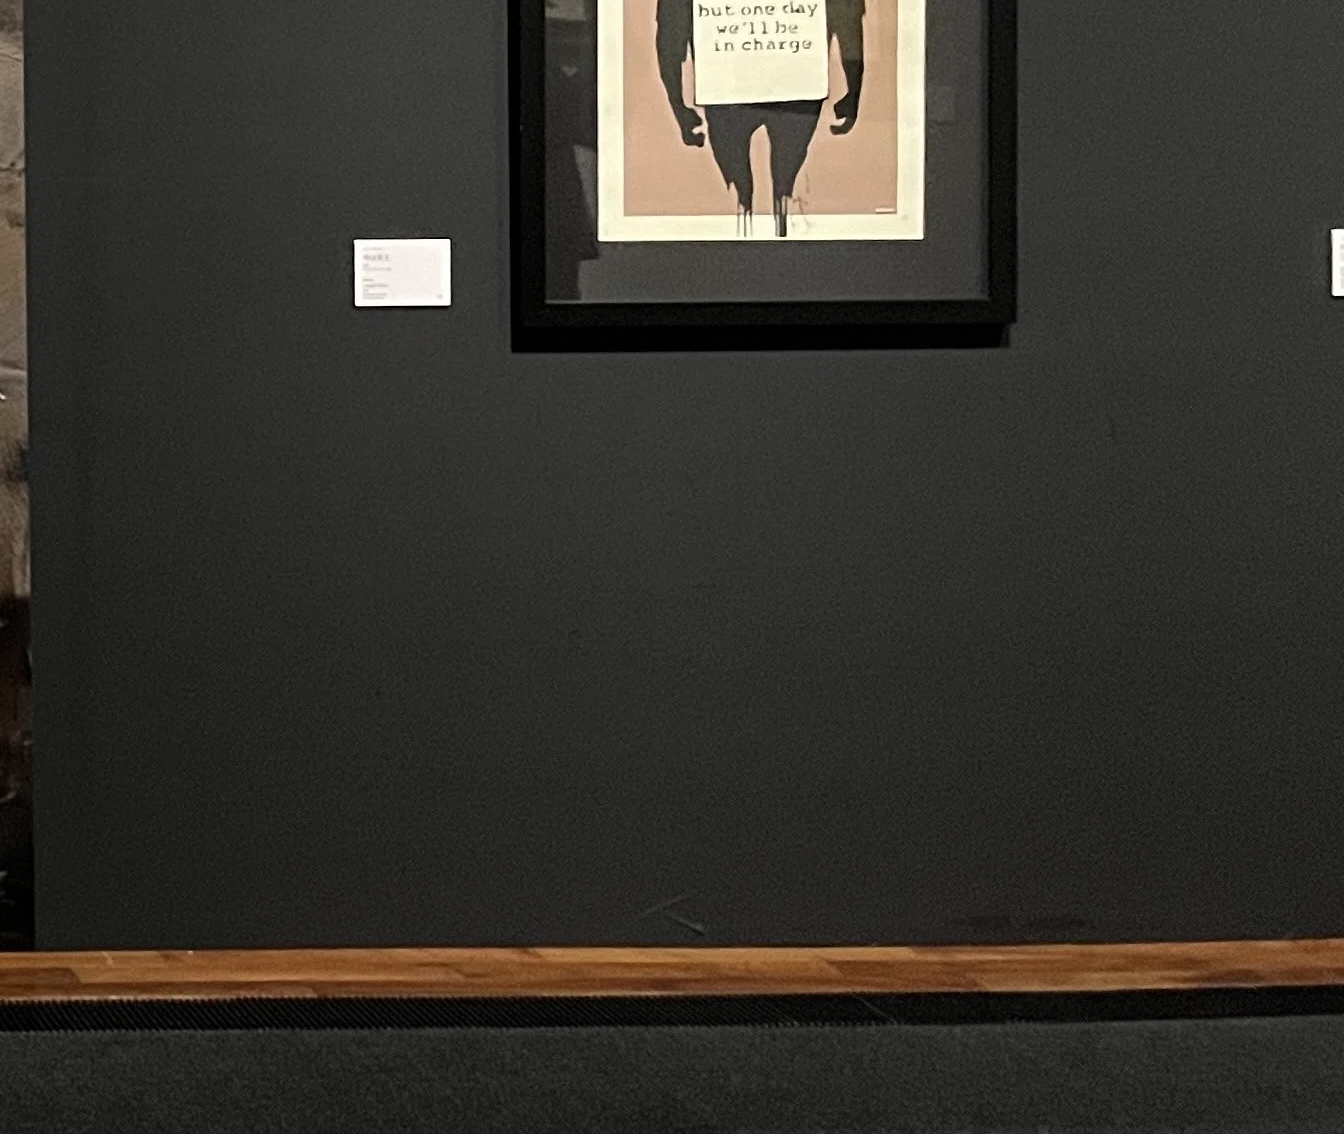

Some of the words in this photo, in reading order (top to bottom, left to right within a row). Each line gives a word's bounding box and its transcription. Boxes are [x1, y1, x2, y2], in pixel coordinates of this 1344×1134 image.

[697, 3, 735, 17] but
[740, 5, 776, 16] one
[782, 0, 818, 17] day
[716, 21, 768, 35] we'll
[775, 20, 799, 34] be
[714, 39, 734, 52] in
[741, 37, 812, 54] charge
